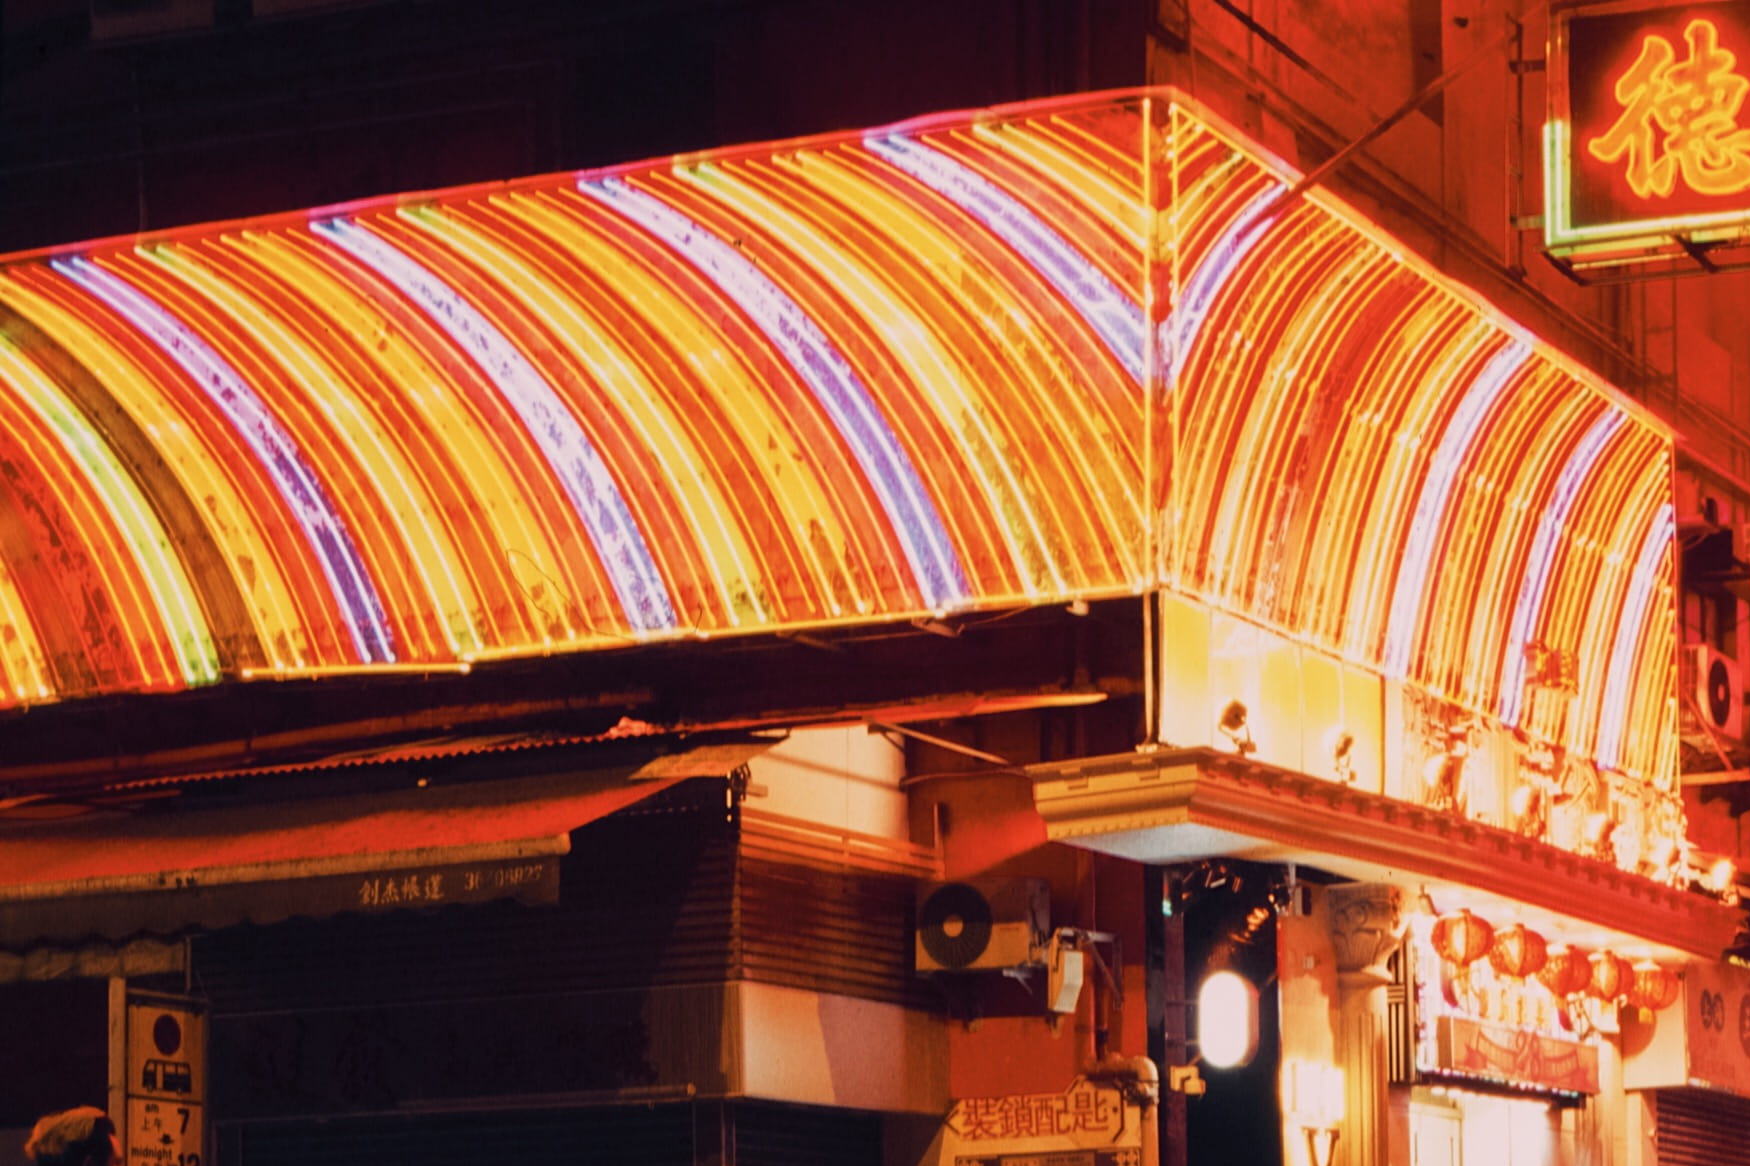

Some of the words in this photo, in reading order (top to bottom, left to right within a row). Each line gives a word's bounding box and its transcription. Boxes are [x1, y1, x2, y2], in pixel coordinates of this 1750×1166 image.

[177, 1108, 190, 1135] 7
[962, 1091, 1108, 1140] 裝鎖配匙
[131, 1146, 172, 1160] midnight
